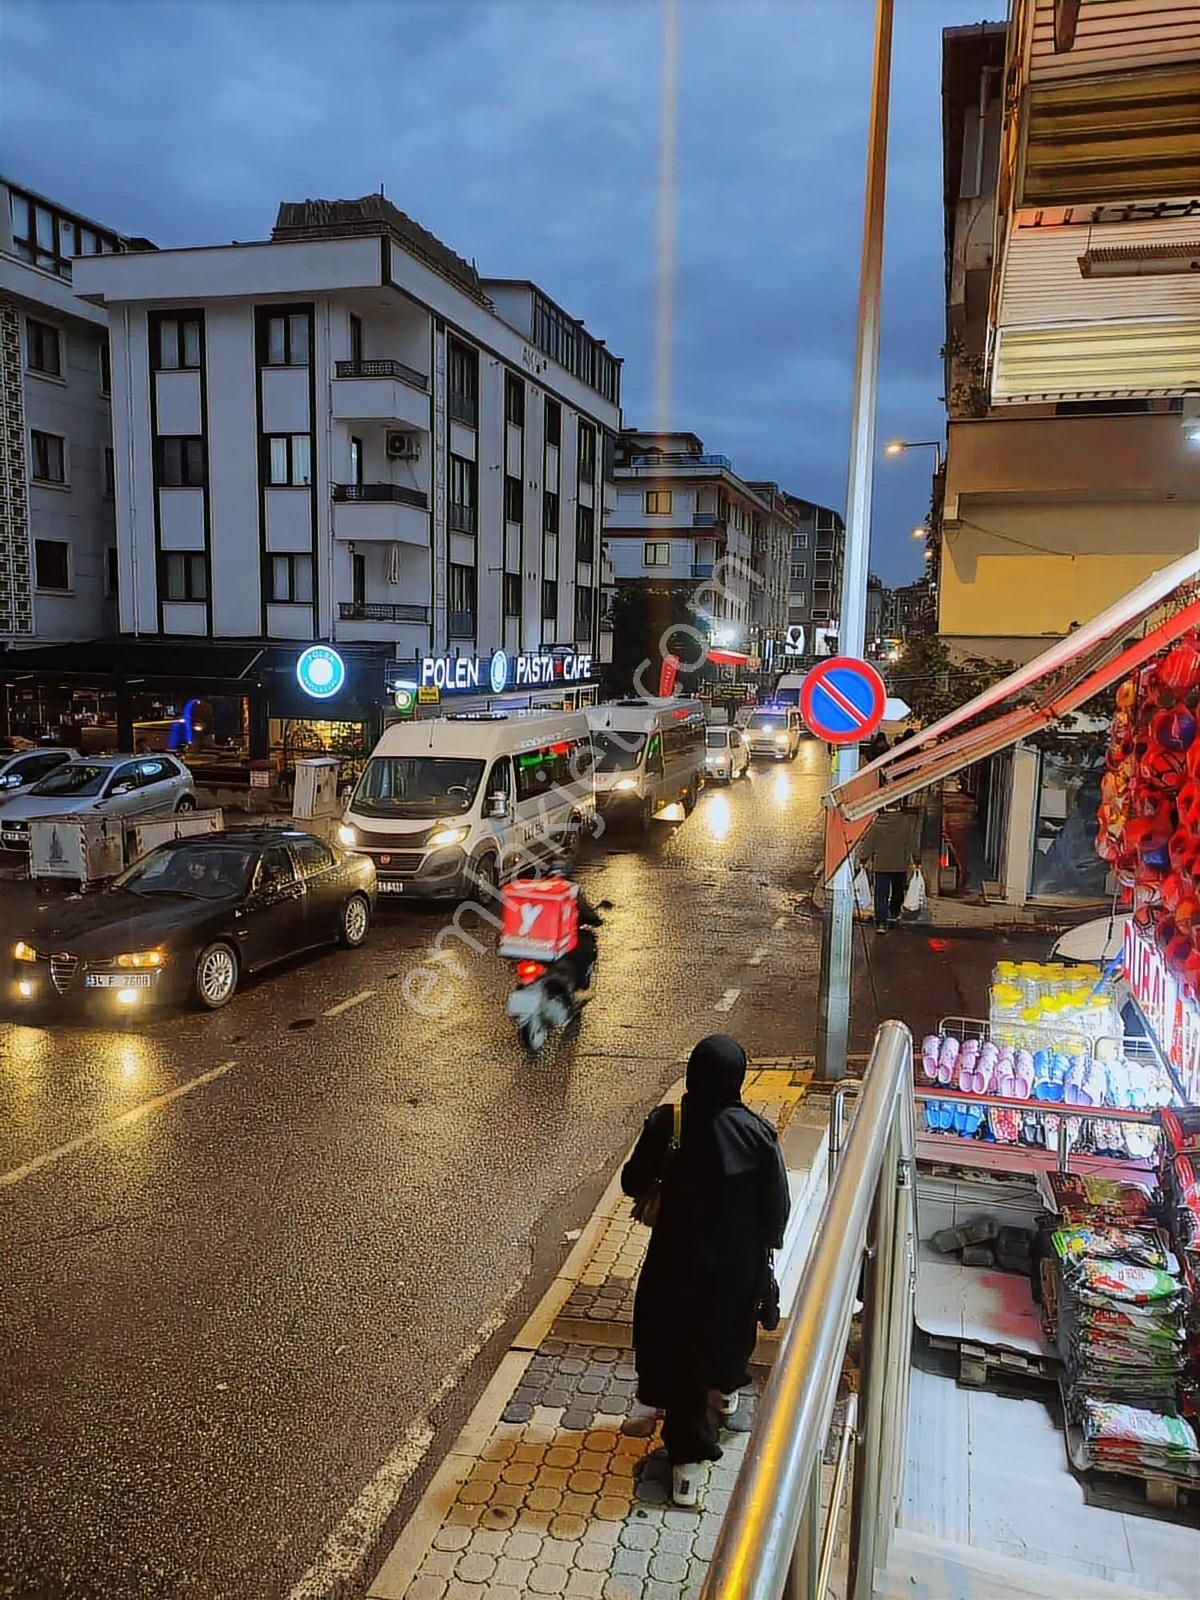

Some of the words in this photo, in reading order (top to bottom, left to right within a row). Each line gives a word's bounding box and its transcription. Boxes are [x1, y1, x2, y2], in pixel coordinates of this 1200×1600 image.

[422, 657, 480, 690] POLEN
[516, 655, 554, 684] PASTA
[563, 654, 592, 681] CAFE
